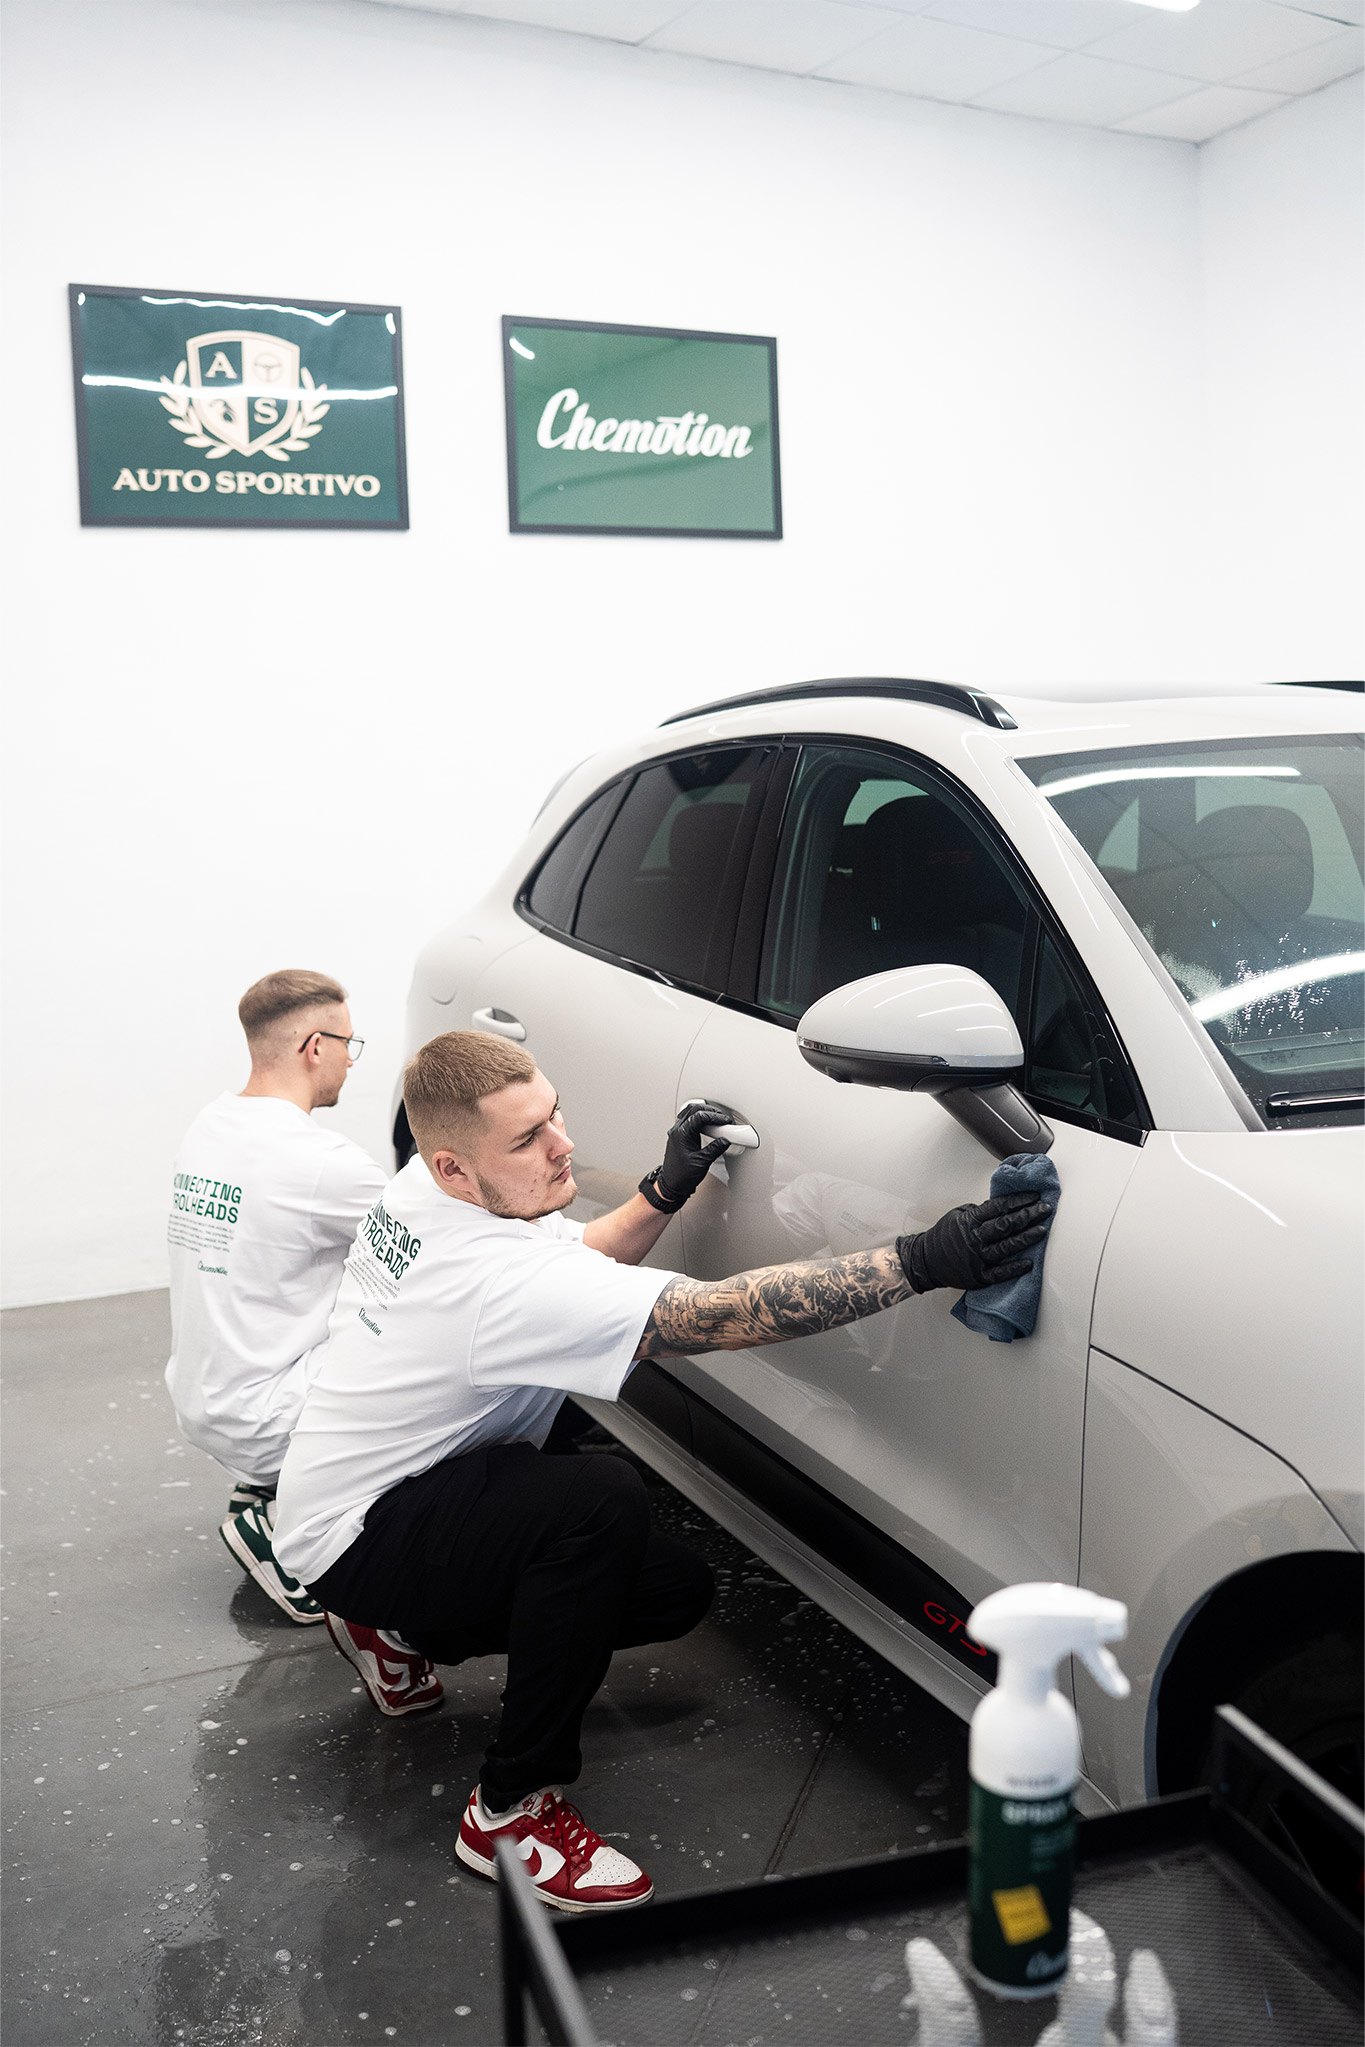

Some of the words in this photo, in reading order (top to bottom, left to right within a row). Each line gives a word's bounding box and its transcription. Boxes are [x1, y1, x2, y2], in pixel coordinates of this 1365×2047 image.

[205, 351, 238, 379] A
[253, 398, 279, 424] S
[537, 387, 753, 458] Chemotion
[112, 467, 211, 493] AUTO
[214, 470, 381, 498] SPORTIVO
[172, 1192, 239, 1224] ROLHEADS
